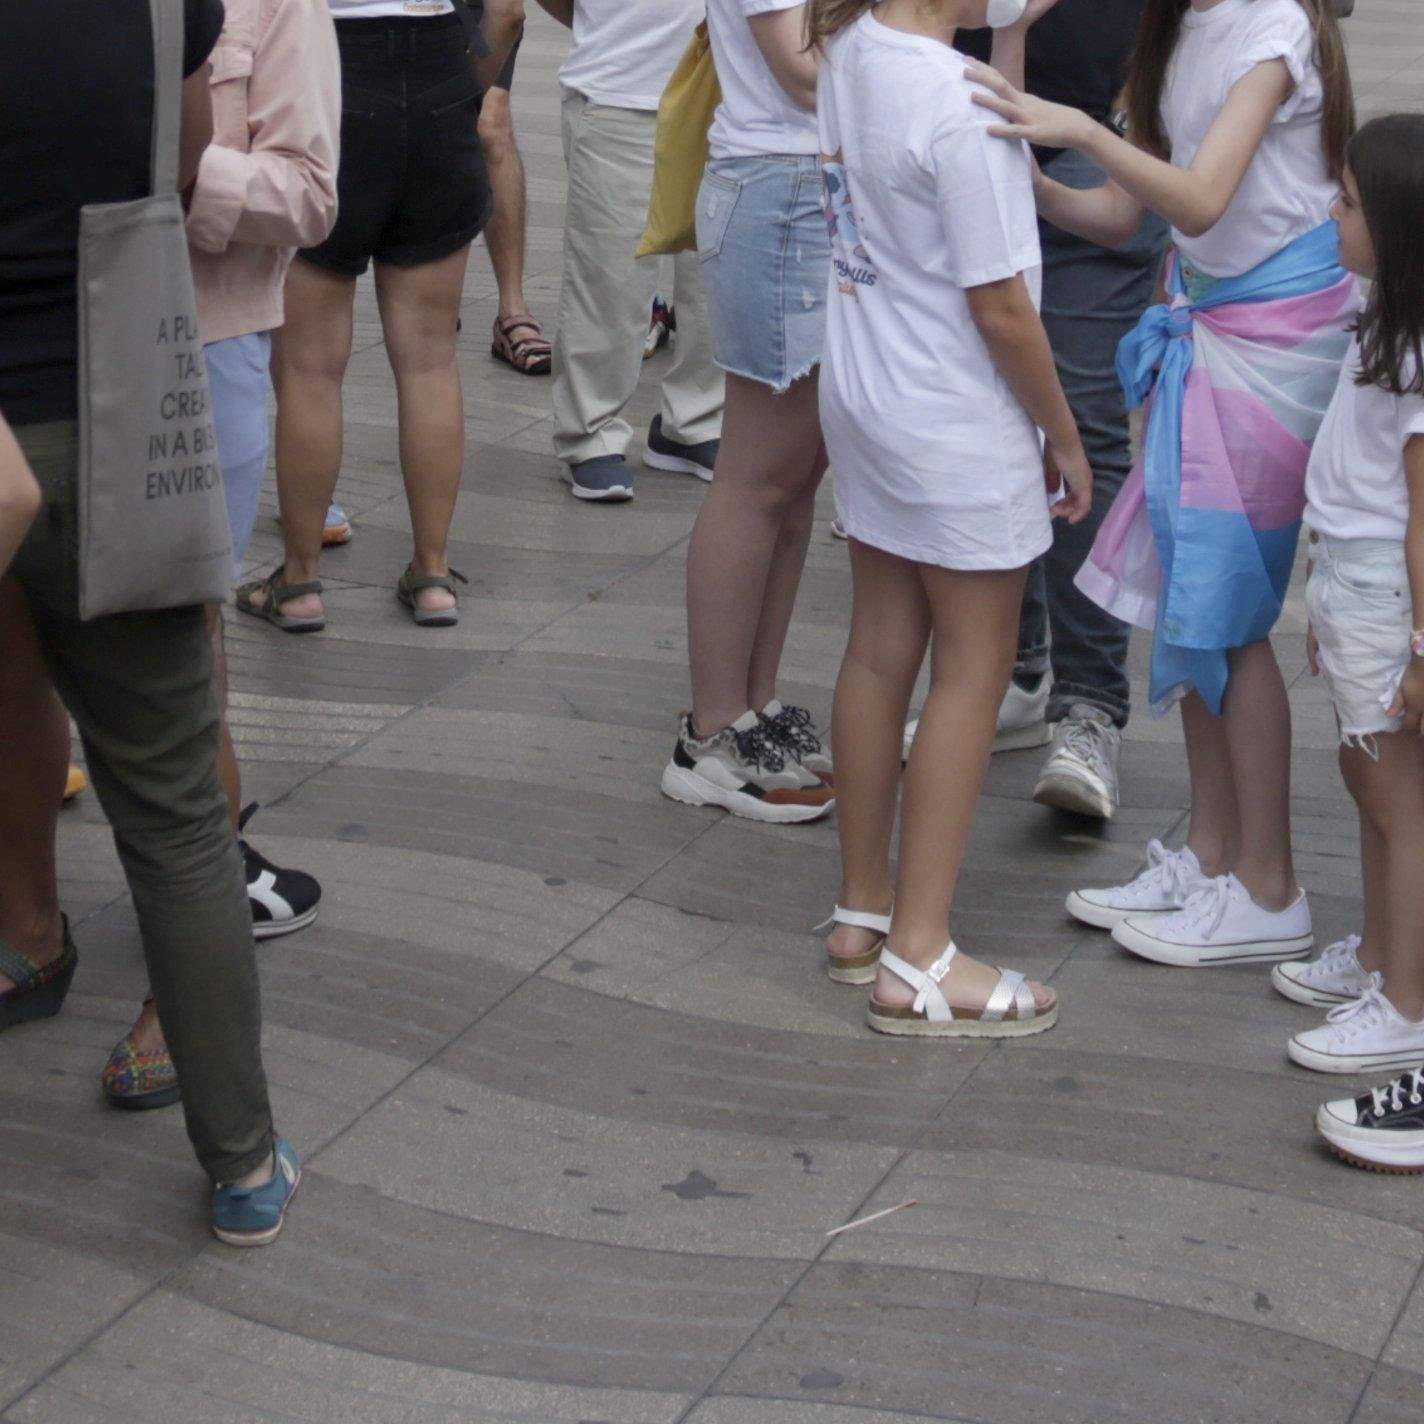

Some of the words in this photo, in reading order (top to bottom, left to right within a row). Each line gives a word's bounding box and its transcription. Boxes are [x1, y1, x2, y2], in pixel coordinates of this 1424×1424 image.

[156, 317, 168, 345] A
[148, 433, 167, 461] IN
[172, 430, 188, 457] A
